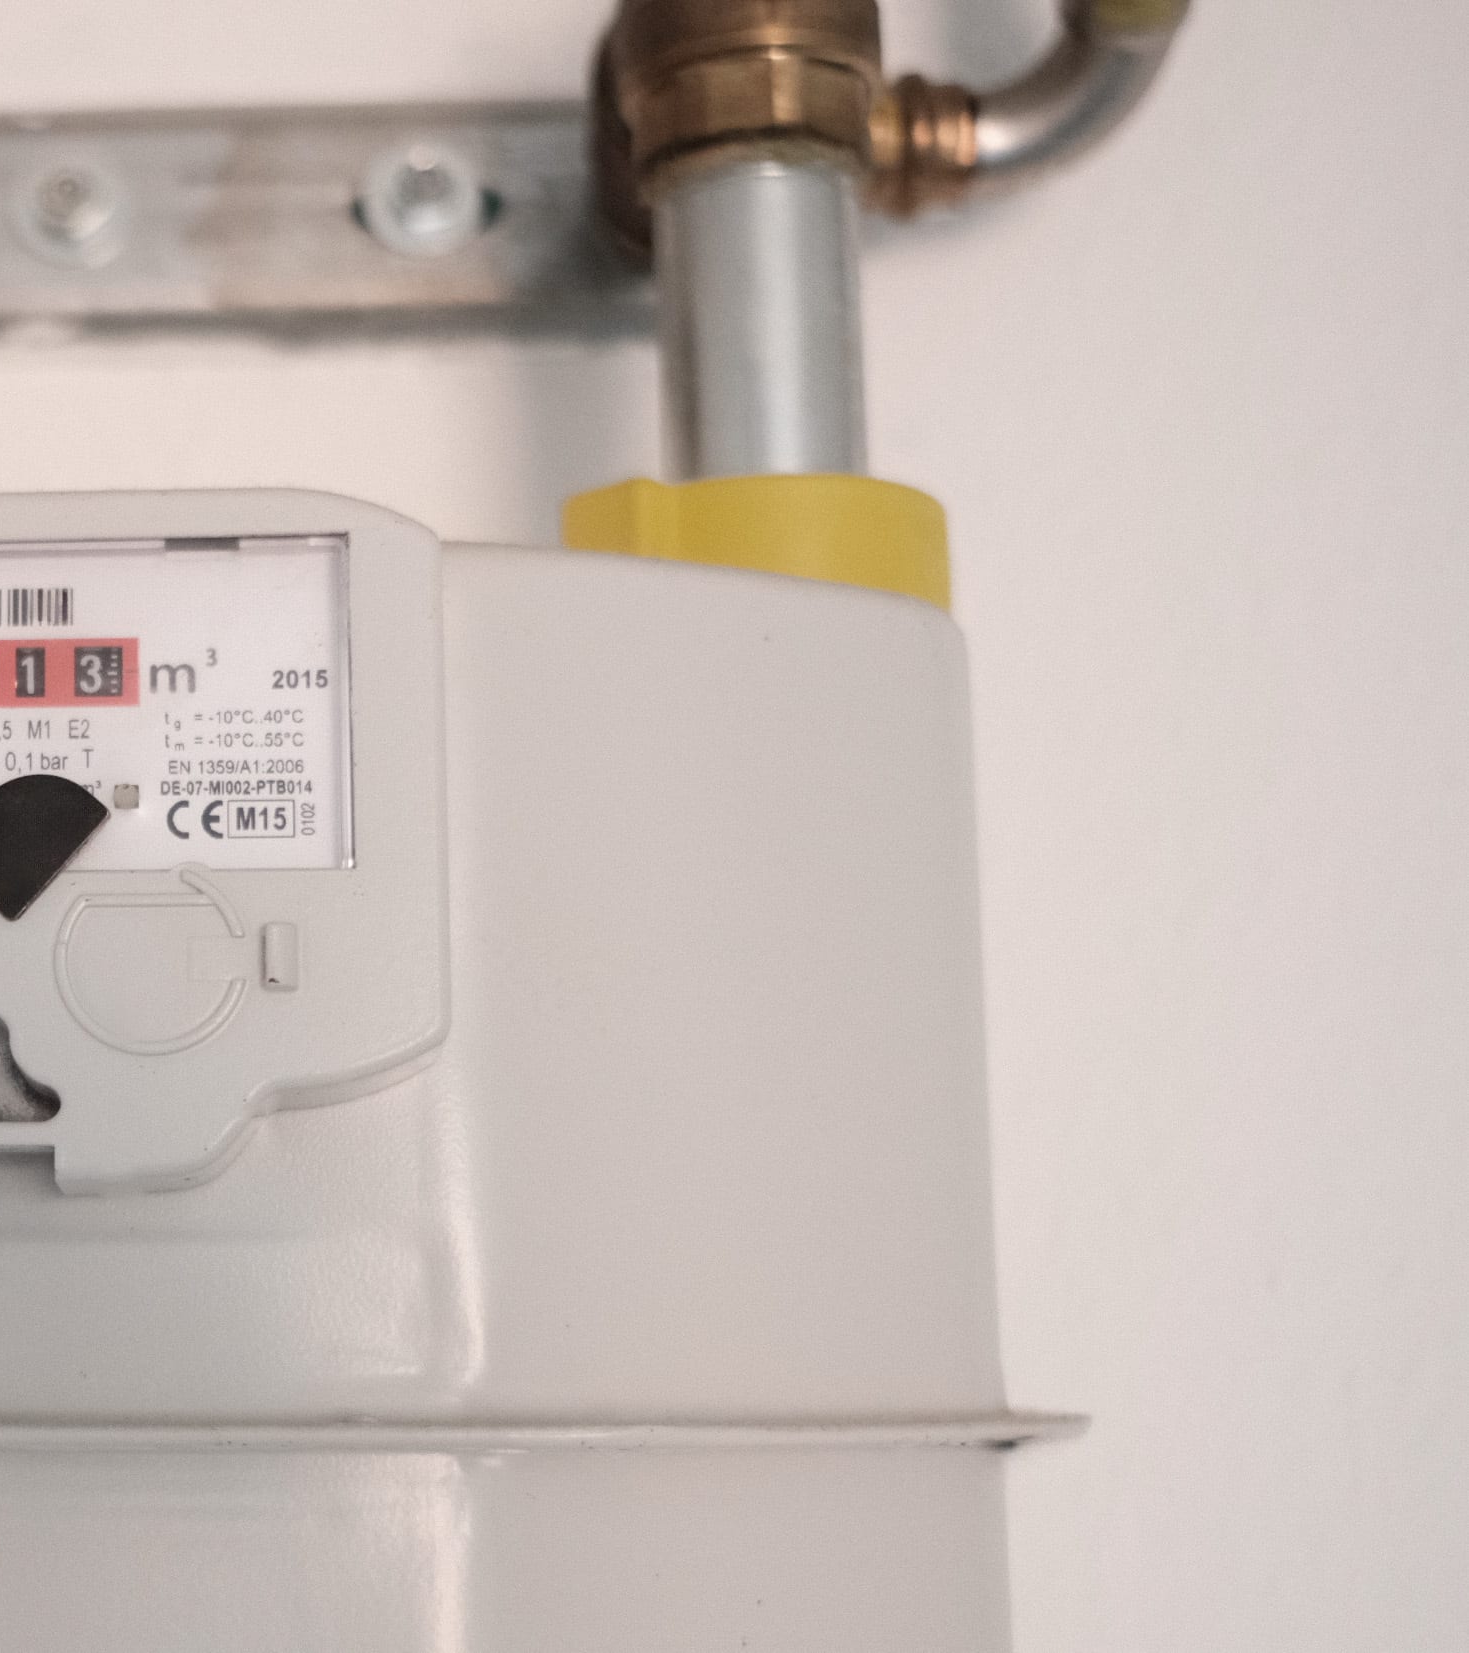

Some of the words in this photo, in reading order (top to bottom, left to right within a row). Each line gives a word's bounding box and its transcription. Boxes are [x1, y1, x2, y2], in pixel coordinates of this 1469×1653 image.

[271, 669, 329, 690] 2015
[27, 720, 52, 740] M1
[68, 719, 91, 740] E2
[40, 750, 68, 771] bar
[82, 748, 94, 770] T
[168, 759, 191, 775] EN
[198, 759, 305, 775] 1359/A1:2006
[235, 806, 287, 831] M15
[300, 802, 316, 836] 0102
